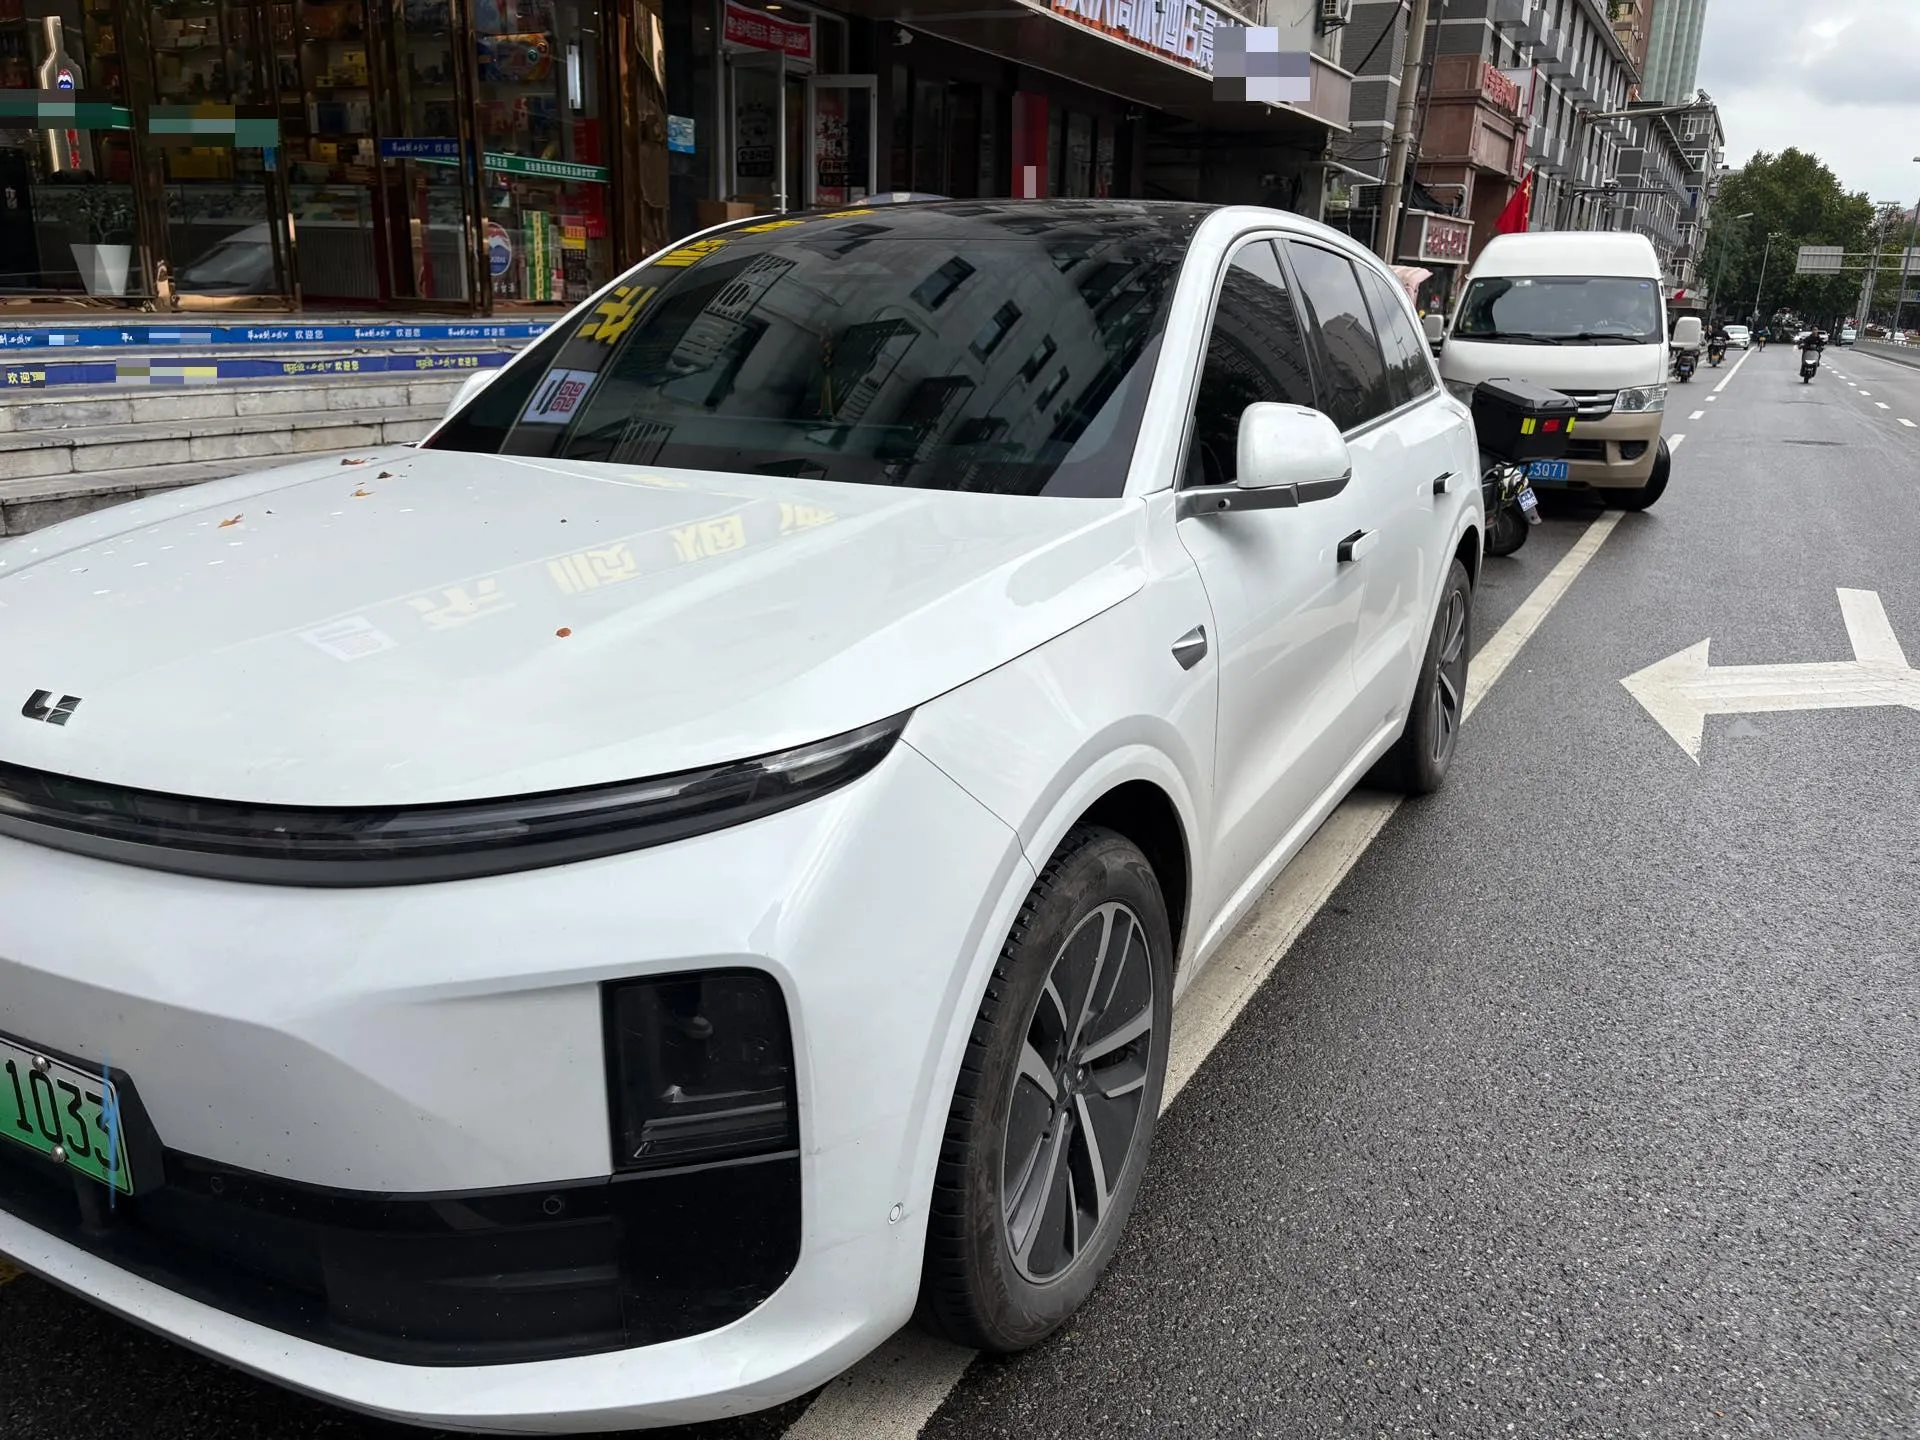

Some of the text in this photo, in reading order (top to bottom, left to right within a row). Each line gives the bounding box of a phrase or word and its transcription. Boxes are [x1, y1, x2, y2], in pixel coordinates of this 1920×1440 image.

[295, 329, 324, 340] 欢迎您
[396, 328, 421, 338] 欢迎您
[484, 328, 506, 337] 欢迎您
[335, 361, 359, 372] 欢迎您
[458, 357, 479, 367] 欢迎您
[7, 371, 46, 385] 欢迎
[6, 1059, 120, 1172] 1033
